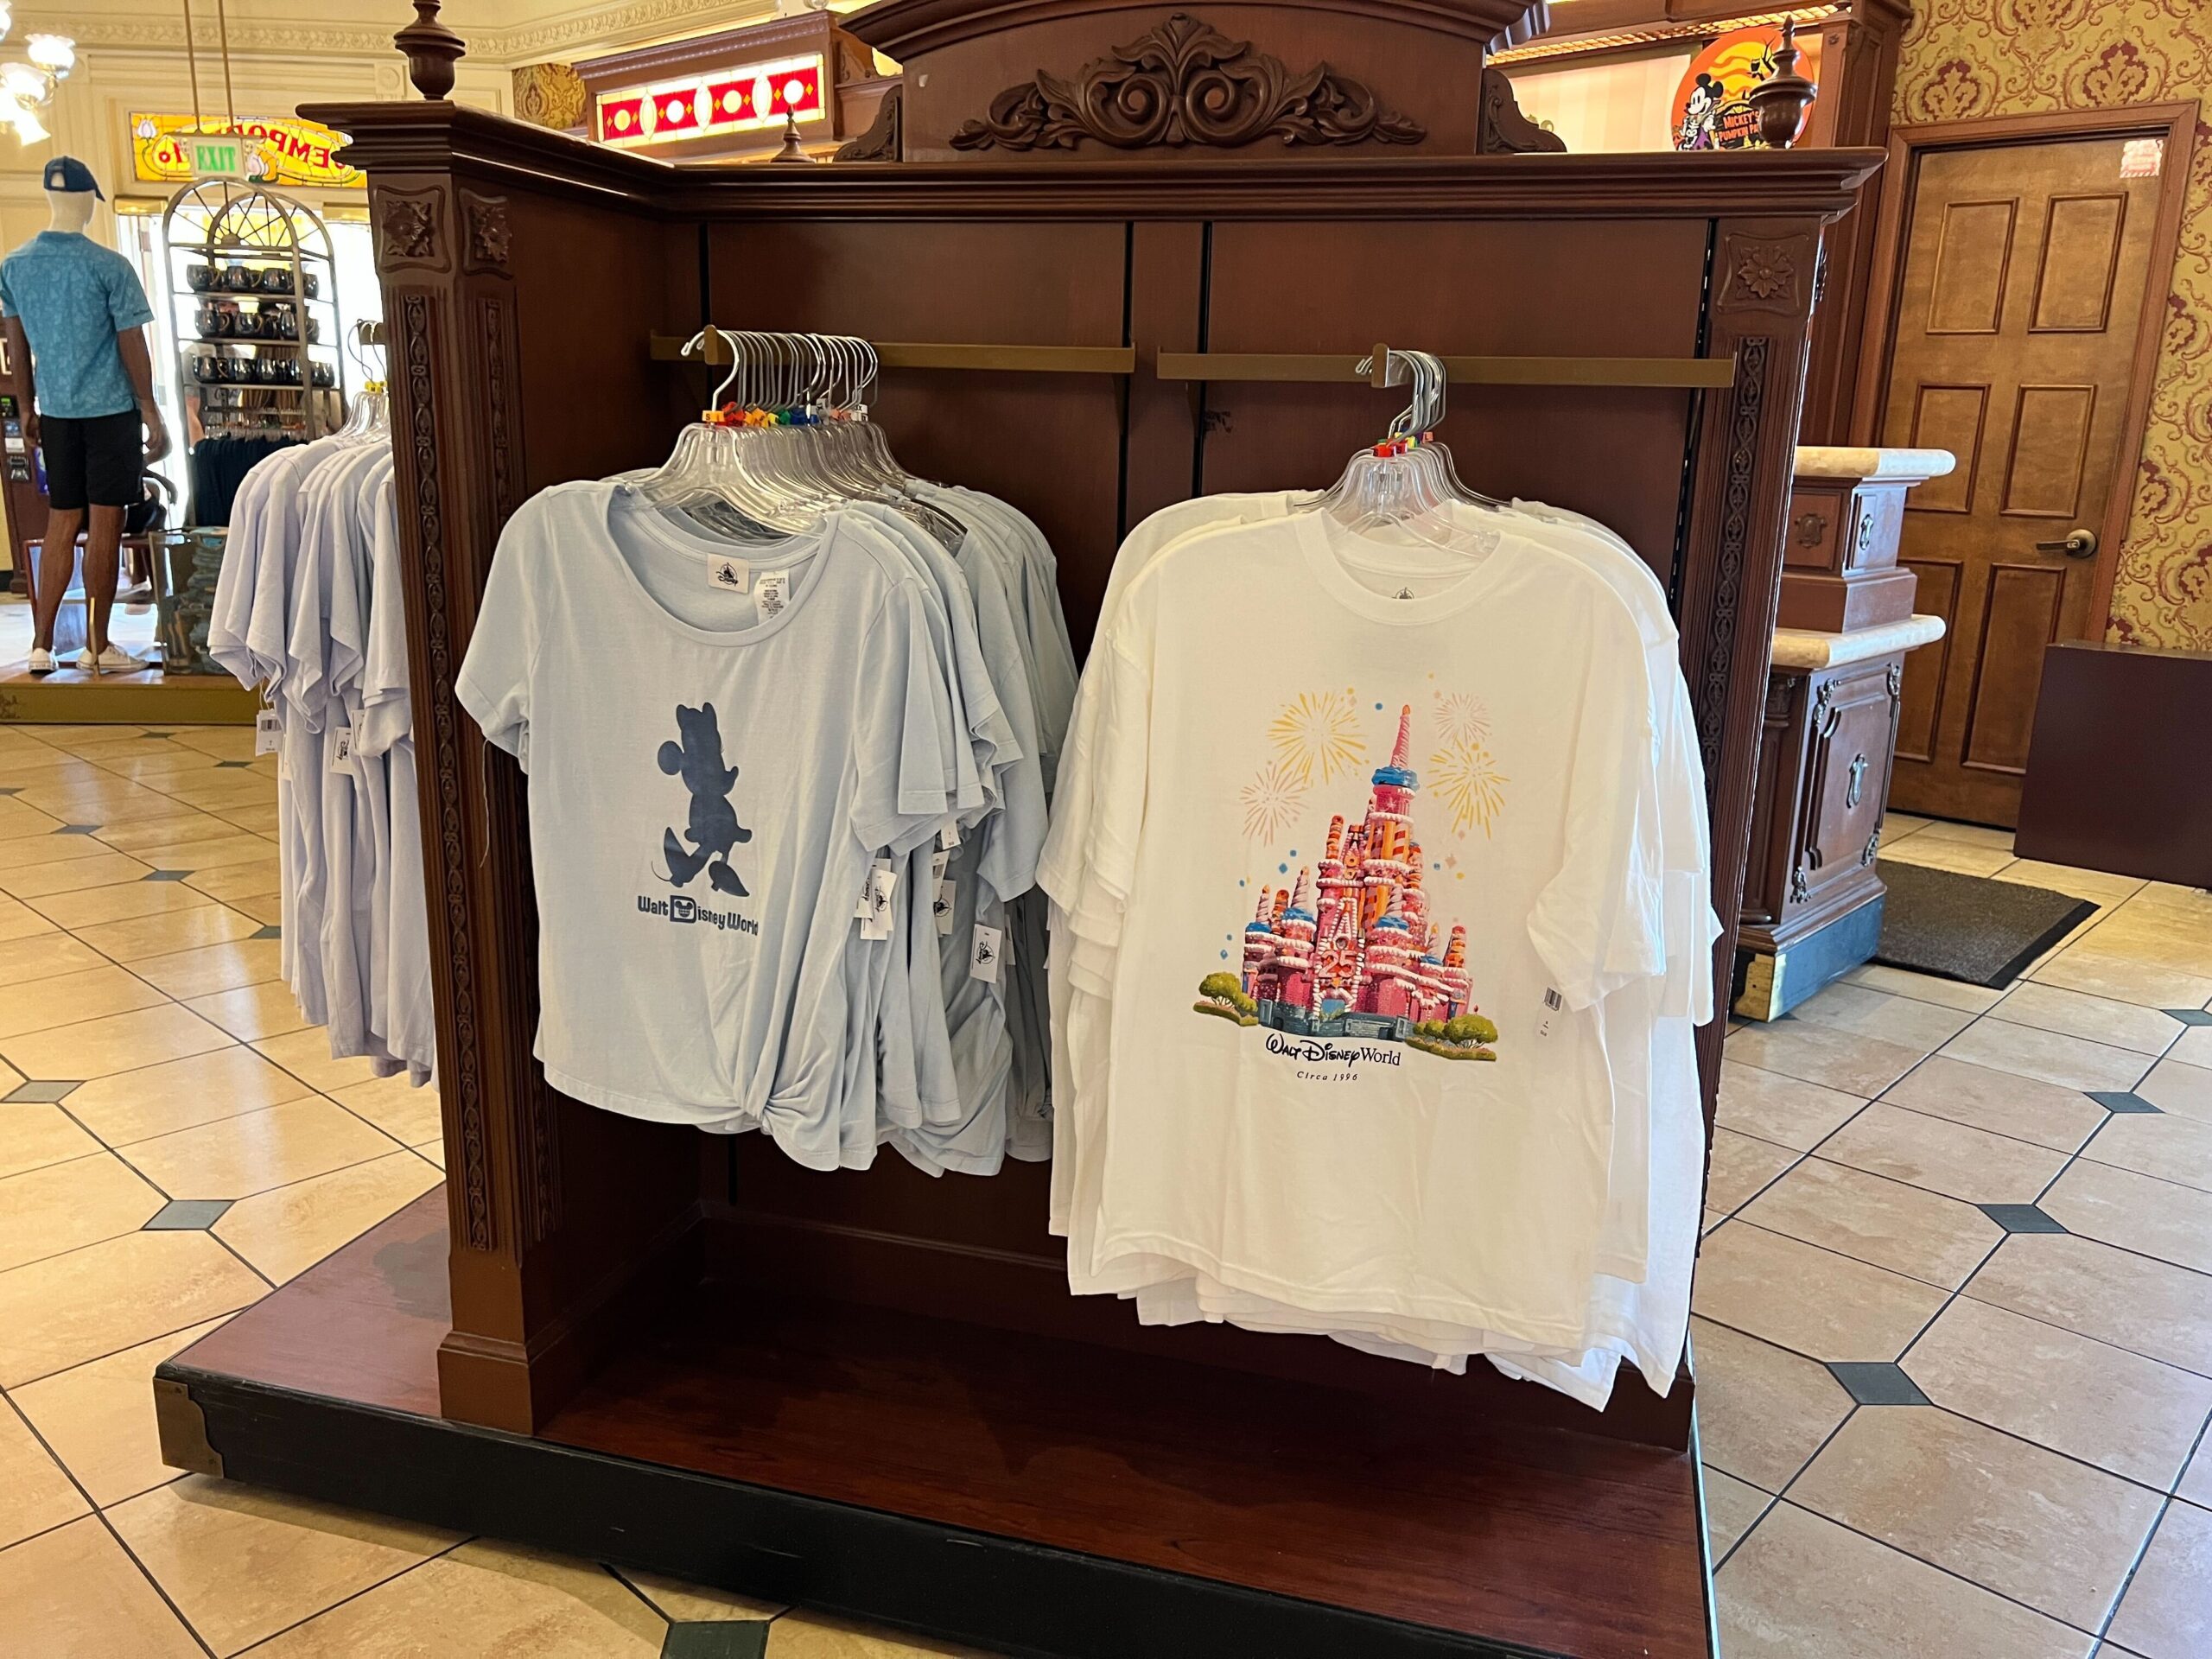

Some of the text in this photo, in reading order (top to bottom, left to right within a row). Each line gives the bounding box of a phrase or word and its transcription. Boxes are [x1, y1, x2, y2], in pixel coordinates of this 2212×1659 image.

[1722, 111, 1759, 129] MICKEY'S
[1718, 126, 1749, 142] PUMPKIN
[195, 145, 236, 172] EXIT
[638, 894, 759, 937] Walt Disney World
[1360, 1047, 1402, 1066] World
[1296, 1071, 1358, 1082] Circa 1996
